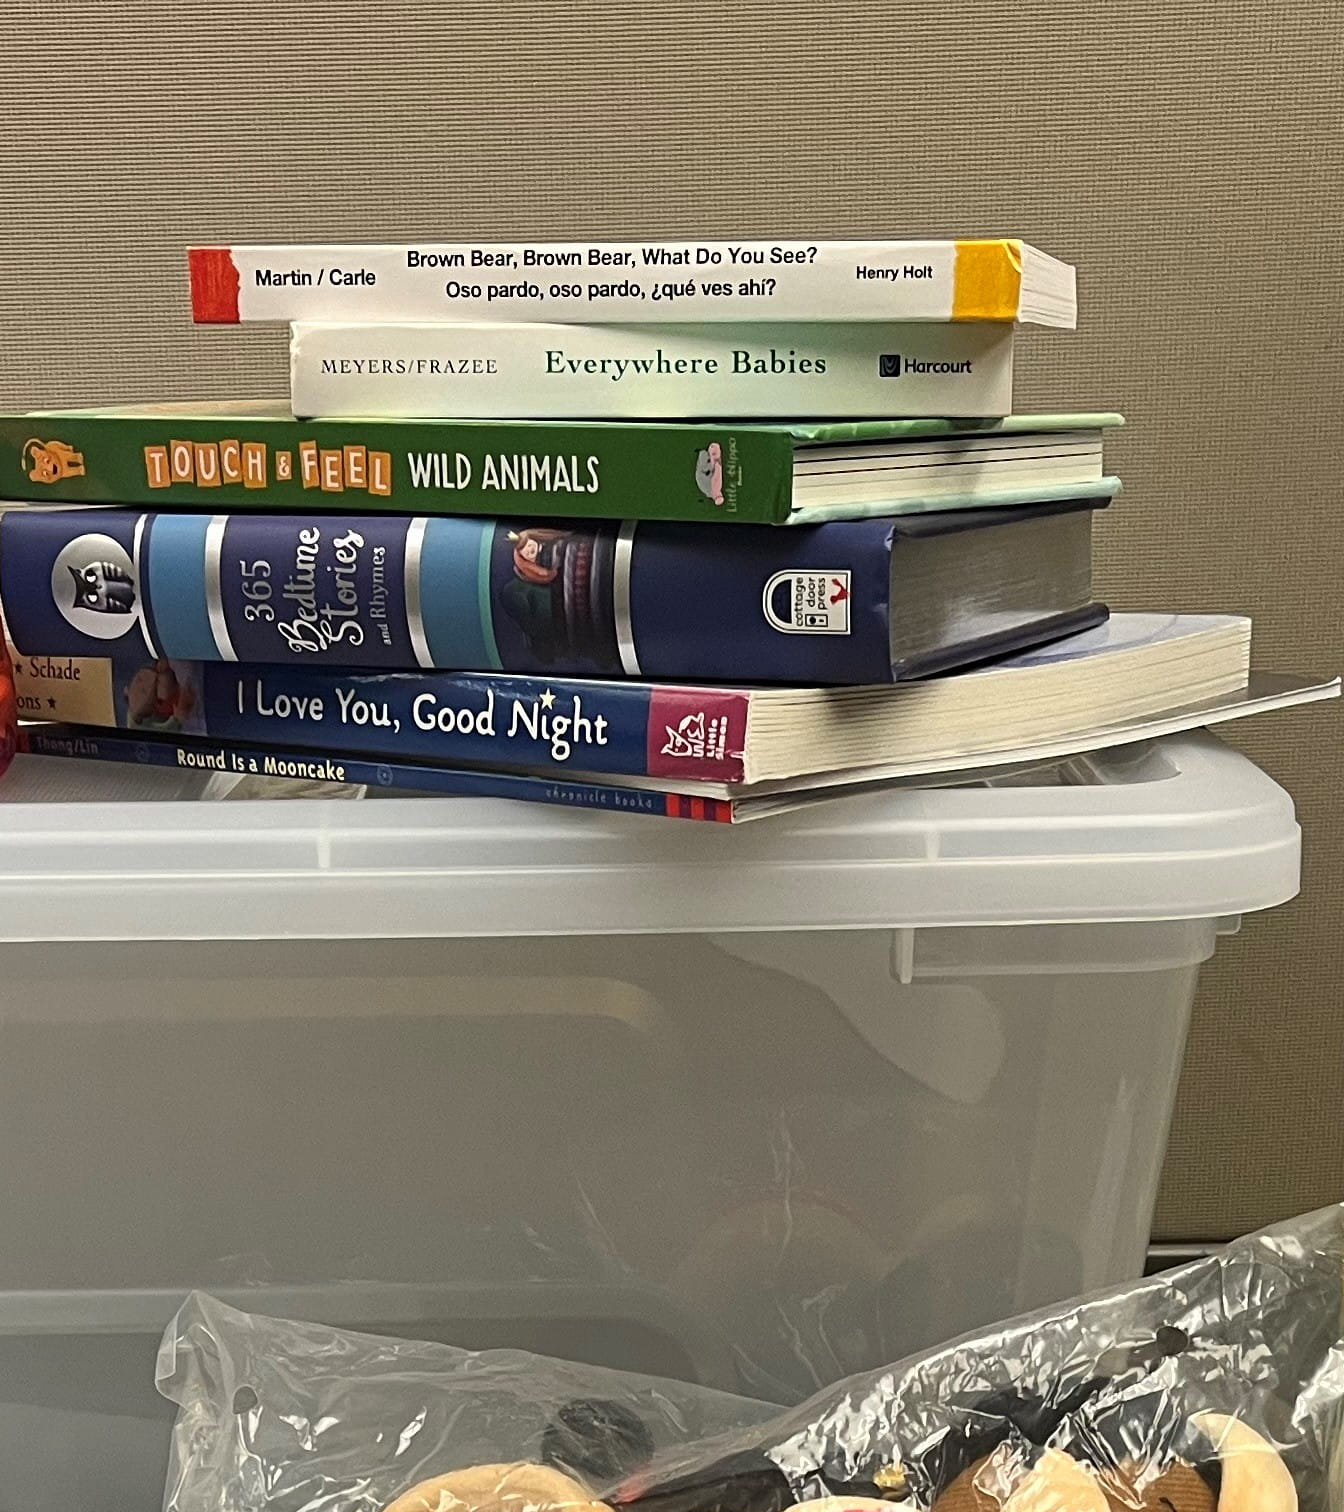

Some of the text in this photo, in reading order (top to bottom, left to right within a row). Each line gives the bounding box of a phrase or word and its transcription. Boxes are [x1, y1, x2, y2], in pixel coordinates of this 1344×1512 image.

[407, 246, 818, 269] Brown Bear, Brown Bear, What Do You See?
[856, 265, 933, 282] Henry Holt
[255, 268, 376, 286] Martin / Carle
[445, 278, 777, 301] Oso pardo, oso pardo, ¿qué ves ahí?
[321, 358, 498, 375] MEYERS/FRAZEE
[545, 350, 826, 381] Everywhere Babies
[905, 359, 972, 375] Harcourt
[149, 445, 599, 494] TOUCH & FEEL WILD ANIMALS
[240, 560, 275, 621] 365
[277, 527, 321, 653] Bedtime
[320, 529, 365, 650] Stories
[369, 546, 392, 645] and Rhymes
[794, 577, 806, 627] cottage
[806, 577, 816, 608] door
[818, 577, 828, 610] press
[30, 657, 81, 681] Schade
[237, 679, 608, 761] I Love You, Good Night
[177, 748, 346, 782] Round Is a Mooncake
